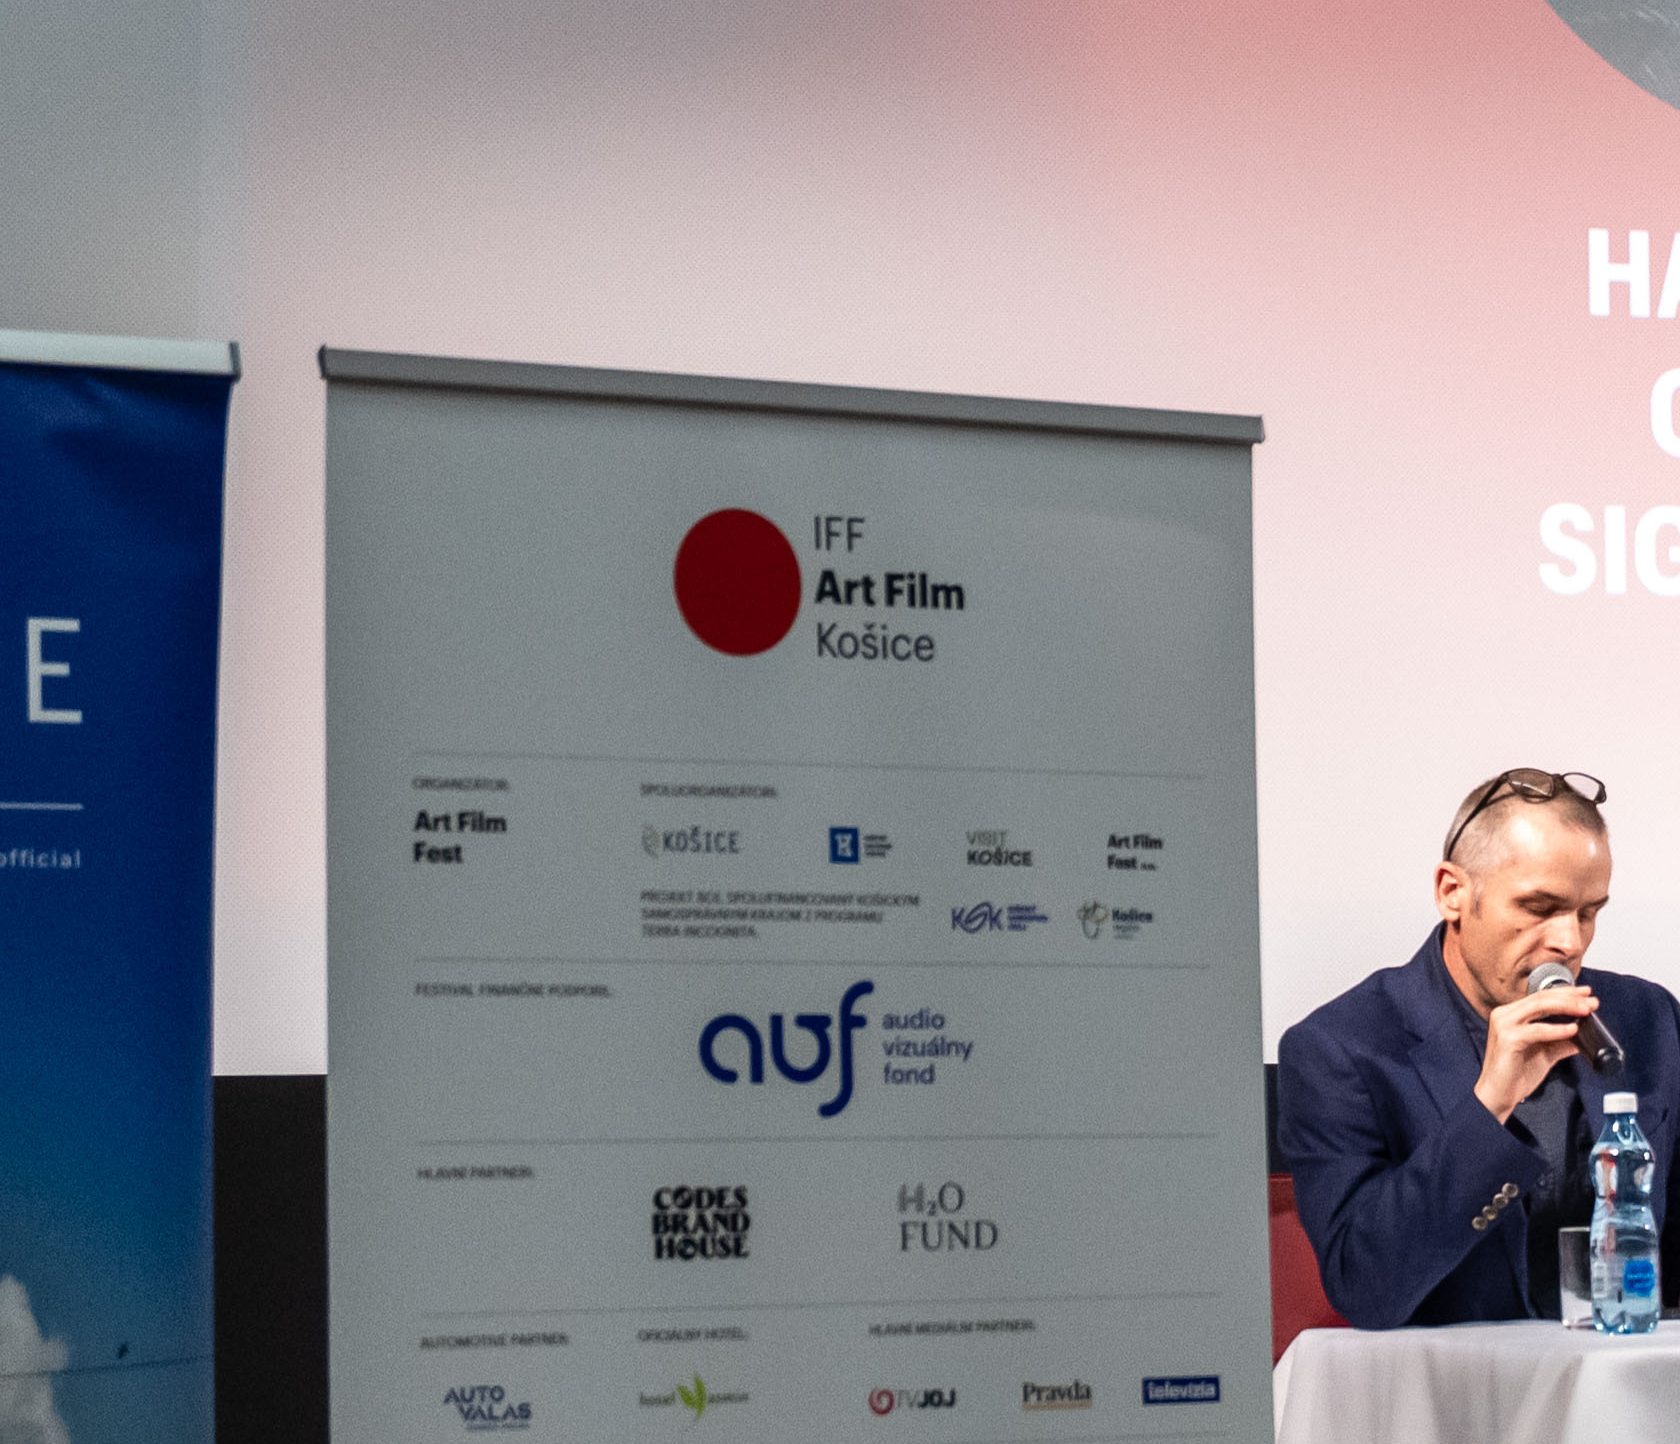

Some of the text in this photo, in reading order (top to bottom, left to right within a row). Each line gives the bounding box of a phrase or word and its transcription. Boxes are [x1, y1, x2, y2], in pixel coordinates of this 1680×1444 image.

[813, 515, 866, 552] IFF
[814, 569, 965, 611] Art Film
[816, 621, 936, 662] Košice
[413, 810, 508, 834] Art Film
[662, 825, 740, 855] KOŠICE
[965, 829, 1008, 846] VISIT
[1107, 833, 1164, 851] Art Film
[412, 841, 463, 864] Fest
[966, 847, 1034, 868] KOŠICE
[1107, 854, 1137, 871] Fest
[882, 1008, 945, 1031] audio
[882, 1036, 974, 1062] vizuálny
[882, 1063, 936, 1085] fond
[652, 1185, 749, 1210] CODES
[651, 1210, 751, 1236] BRAND
[898, 1219, 999, 1252] FUND
[654, 1236, 750, 1261] HOUSE
[443, 1384, 506, 1405] AUTO
[1022, 1379, 1092, 1404] Pravda
[458, 1402, 533, 1422] VALAS
